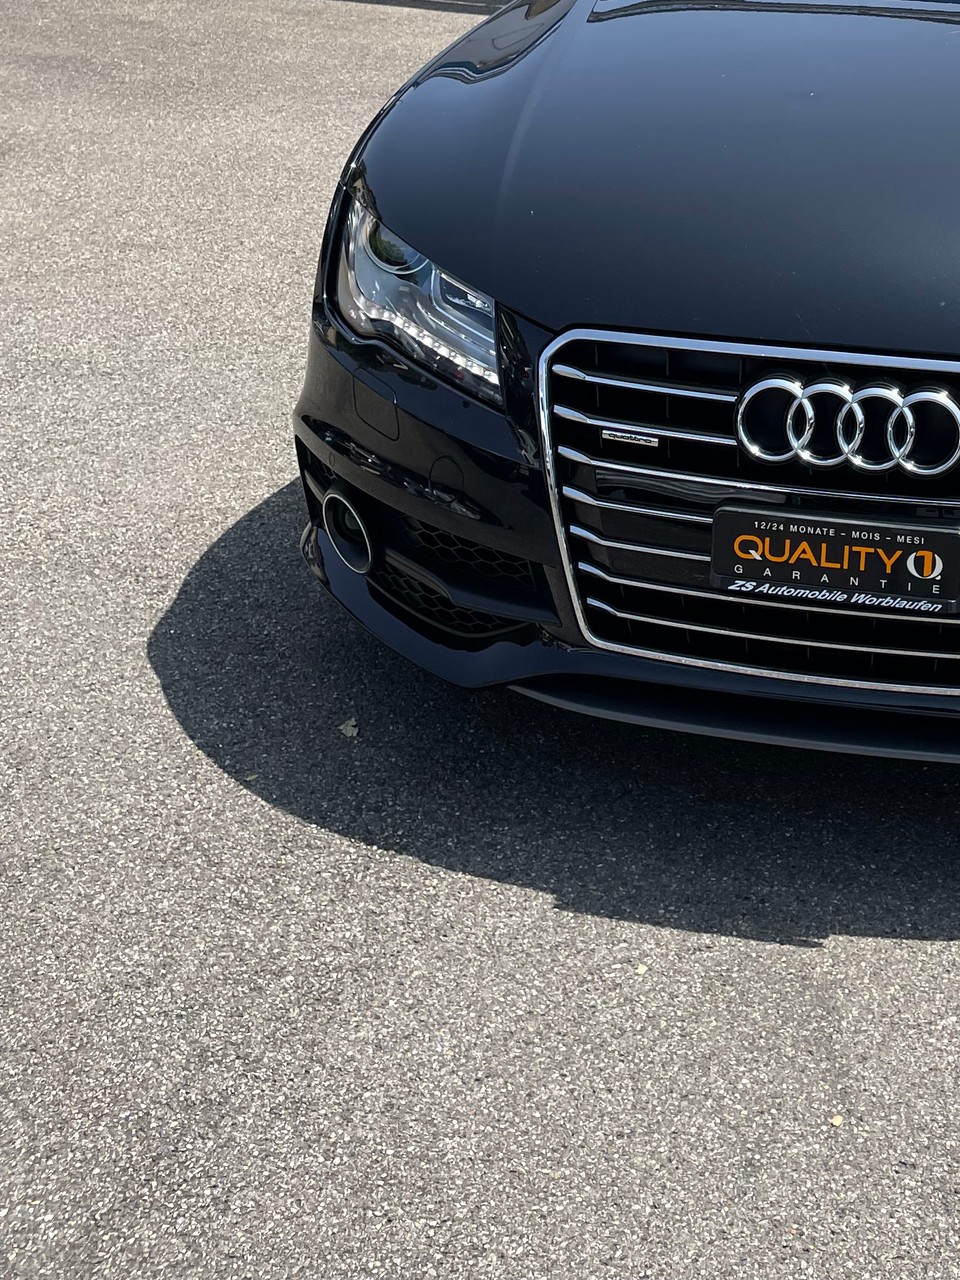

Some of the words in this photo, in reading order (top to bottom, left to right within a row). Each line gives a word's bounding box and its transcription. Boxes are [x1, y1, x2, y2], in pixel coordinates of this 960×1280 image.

[754, 521, 784, 531] 12/24
[789, 524, 836, 537] MONATE
[851, 530, 880, 541] MOIS
[896, 535, 925, 545] MESI
[733, 534, 903, 574] QUALITY
[734, 564, 940, 594] GARANTIE
[728, 580, 757, 592] ZS
[754, 582, 848, 602] Automobile
[850, 592, 942, 612] Worblaufen
